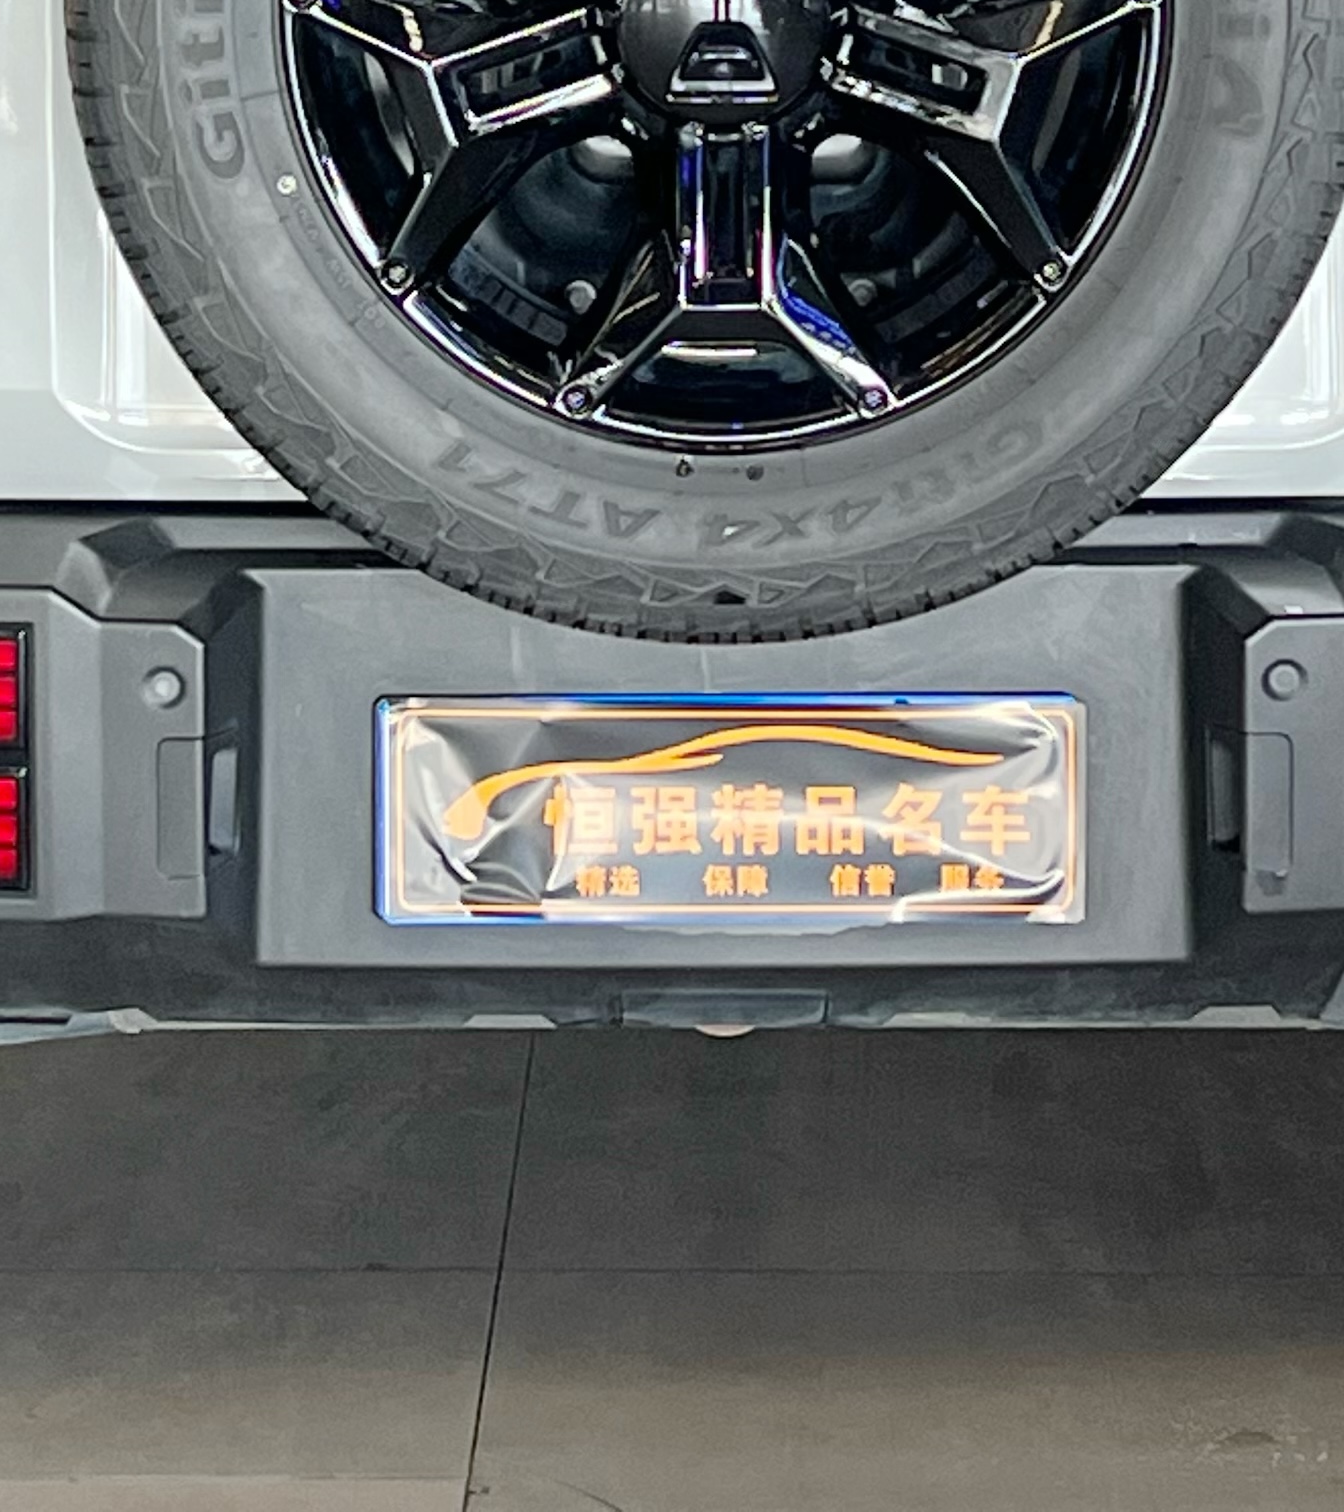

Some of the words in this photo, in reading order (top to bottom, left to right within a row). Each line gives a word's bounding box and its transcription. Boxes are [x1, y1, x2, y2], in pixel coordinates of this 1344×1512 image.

[544, 784, 1034, 857] 恒强精品名车
[575, 864, 641, 898] 精选
[702, 864, 770, 897] 保障
[829, 864, 896, 897] 信誉
[939, 864, 1005, 894] 服务
